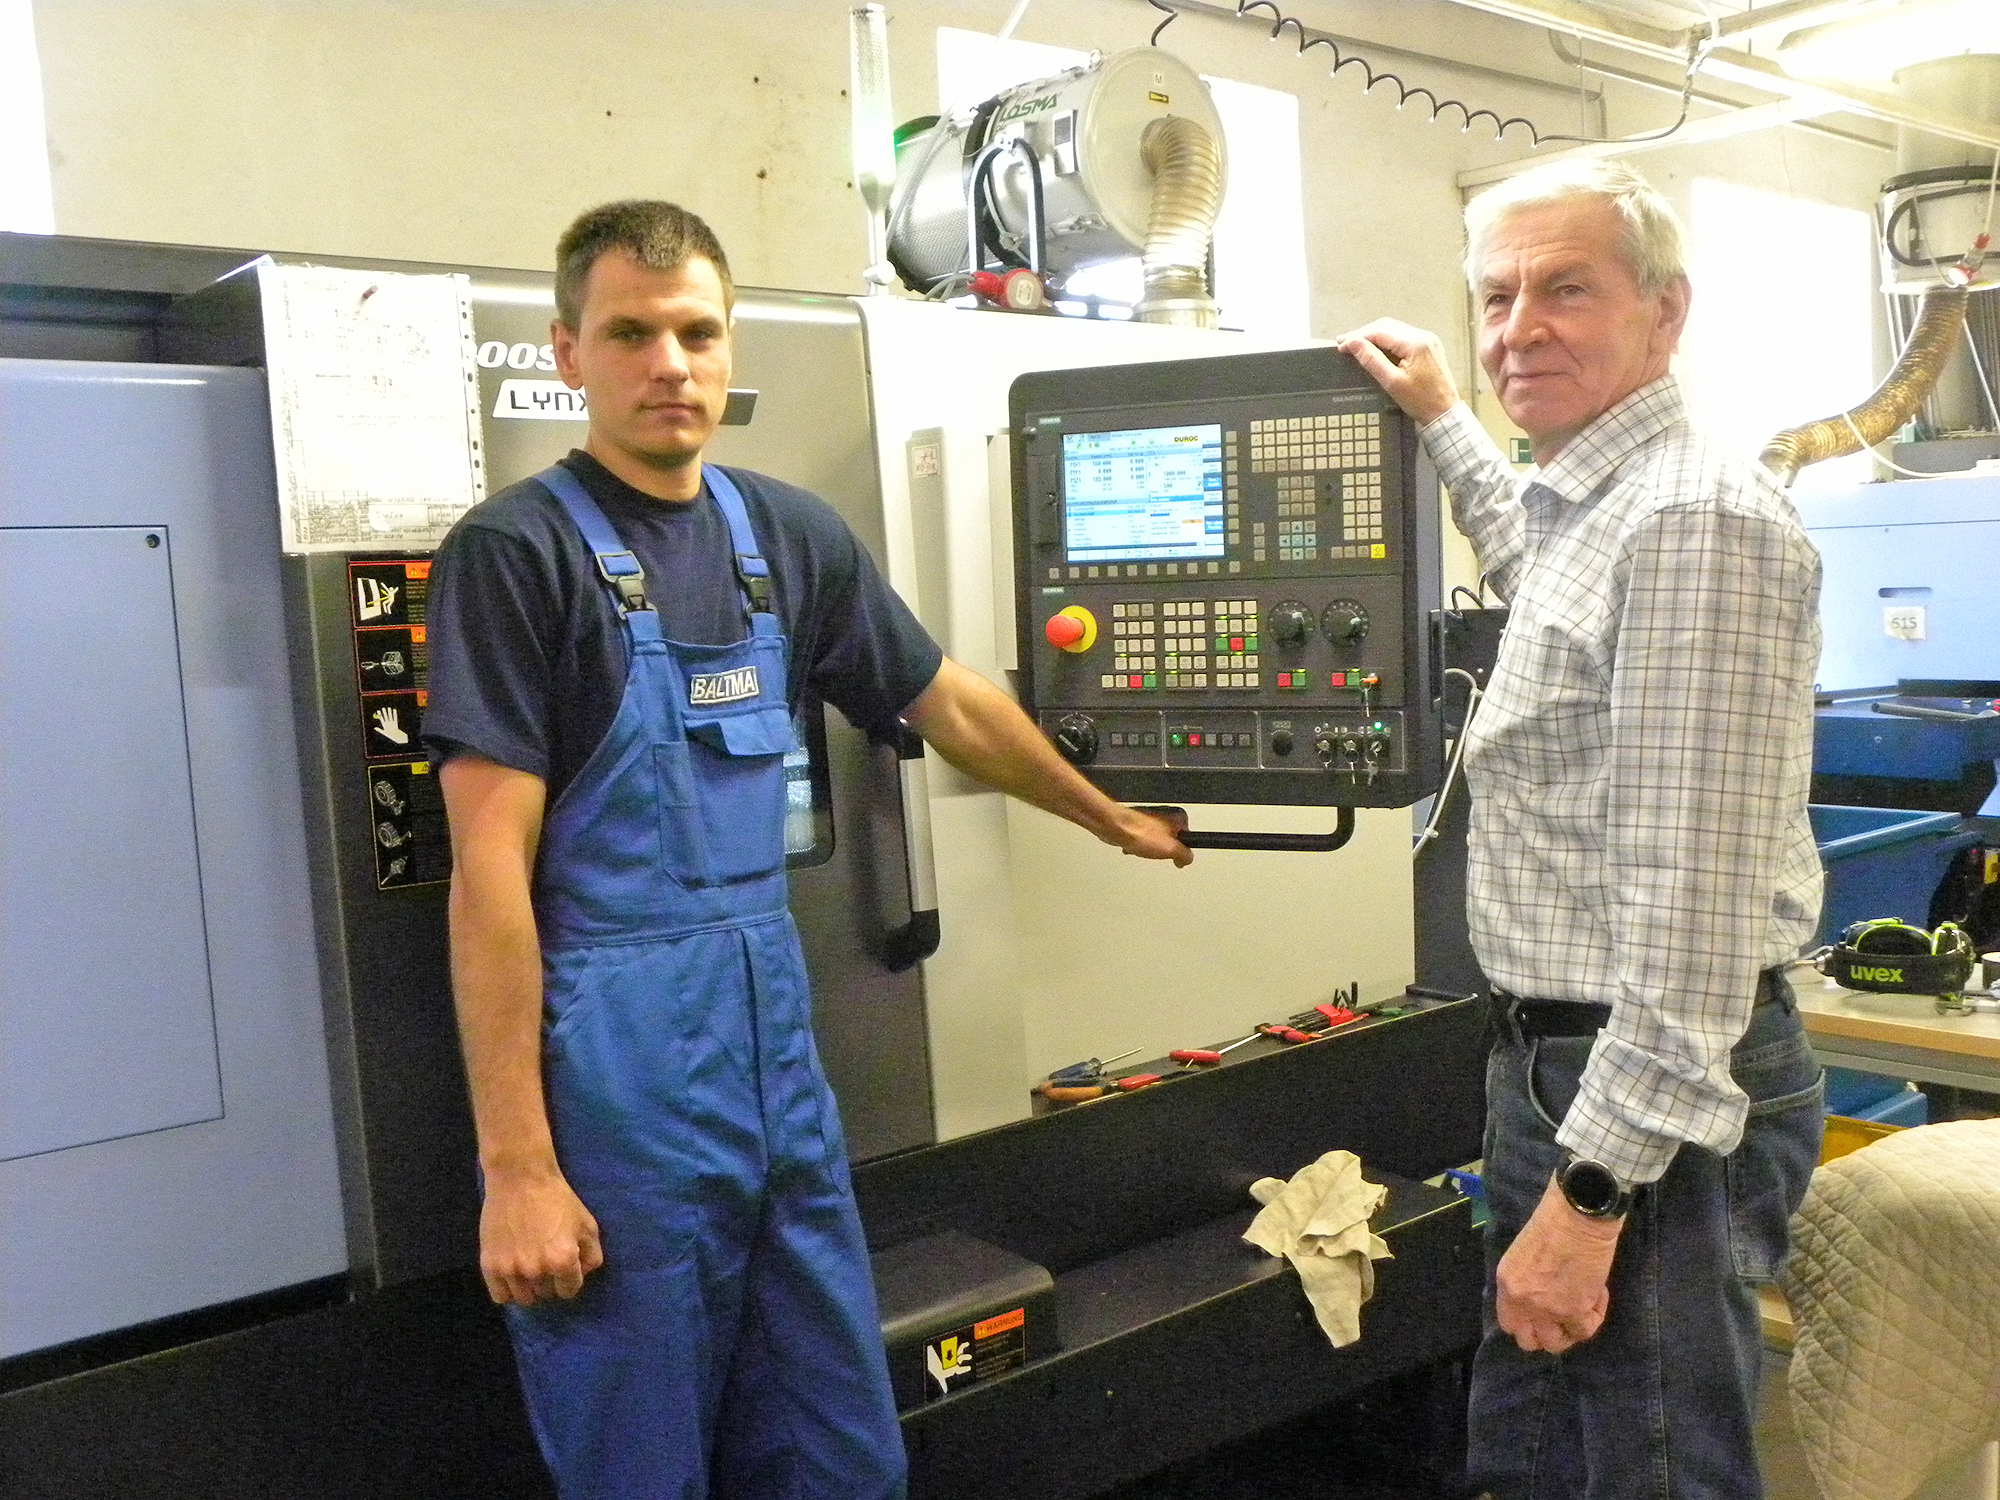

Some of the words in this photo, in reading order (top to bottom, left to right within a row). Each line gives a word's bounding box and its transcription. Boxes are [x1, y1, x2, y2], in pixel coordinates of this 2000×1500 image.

[999, 93, 1058, 121] LOSMA
[1174, 435, 1199, 443] DUROC
[693, 670, 756, 700] BALTMA
[1850, 964, 1904, 983] uvex
[986, 1312, 1022, 1331] WARNING
